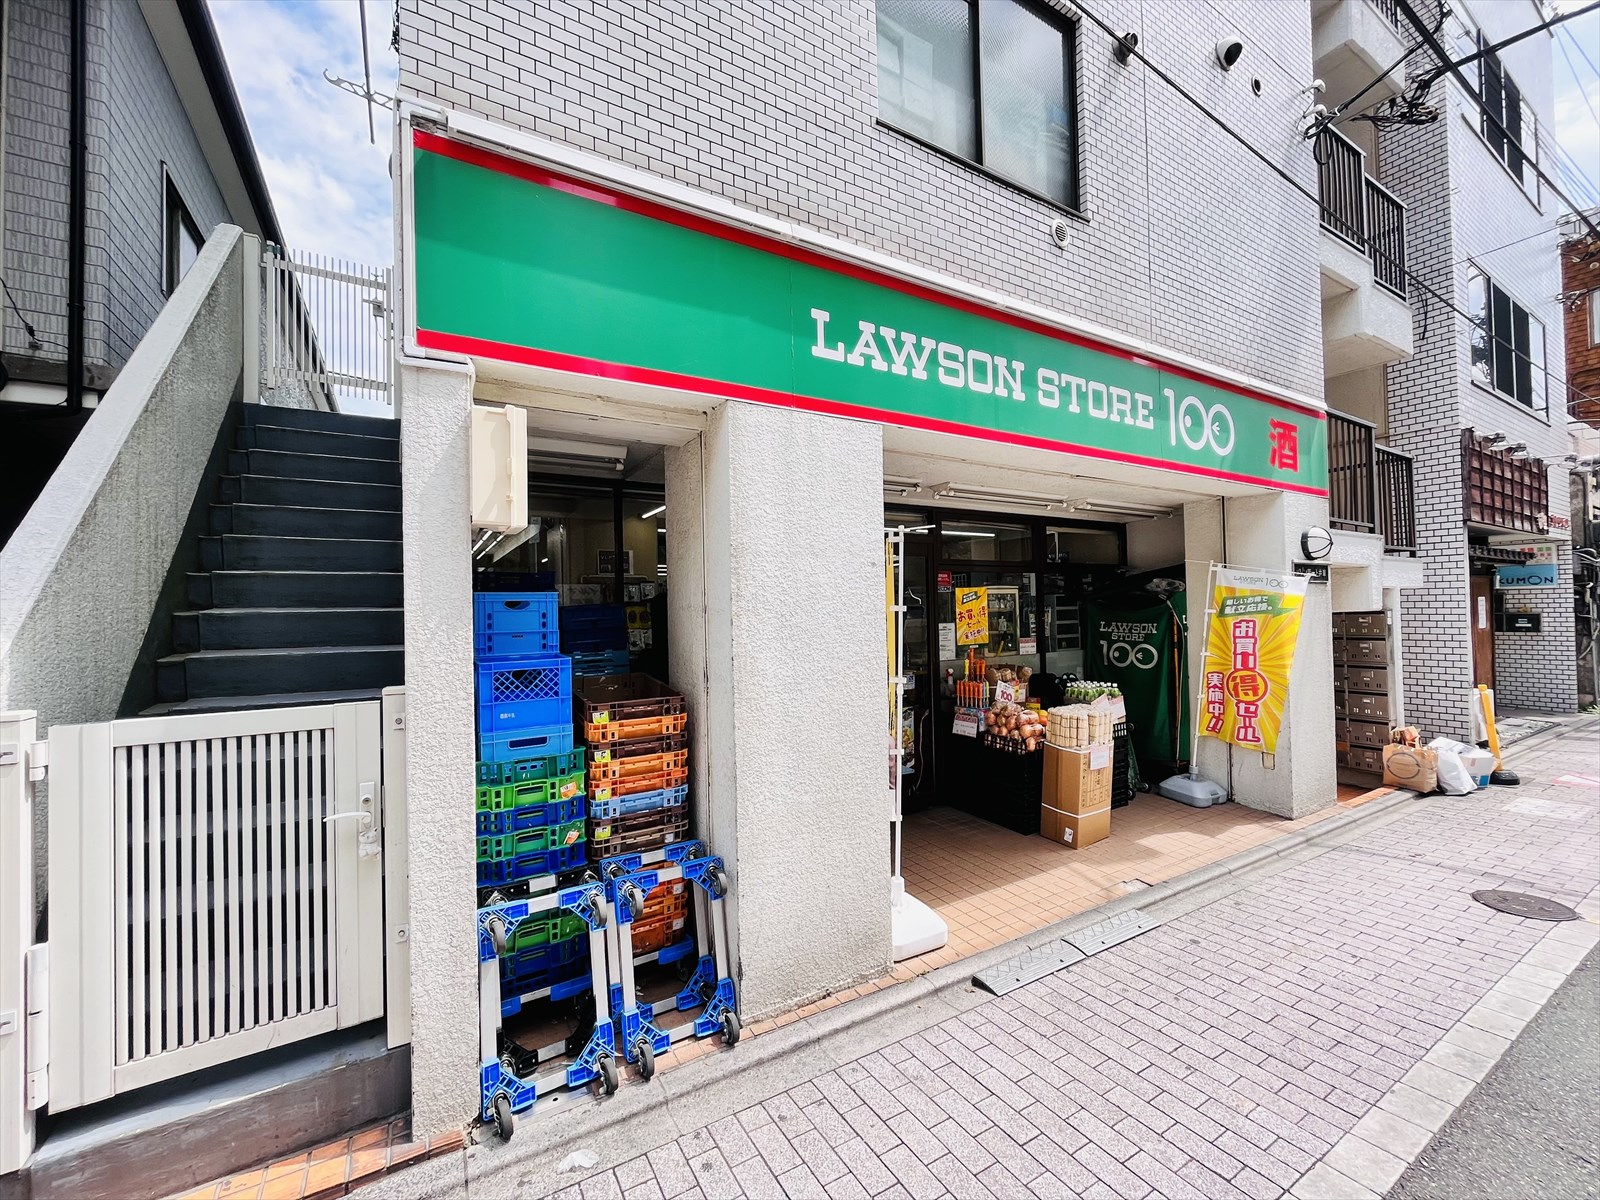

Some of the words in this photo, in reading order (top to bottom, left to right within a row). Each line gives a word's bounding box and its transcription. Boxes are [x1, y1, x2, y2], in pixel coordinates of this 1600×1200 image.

[811, 308, 1025, 401] LAWSON
[1038, 368, 1154, 430] STORE
[1165, 388, 1236, 456] 100
[1268, 418, 1299, 473] 酒
[1233, 575, 1264, 583] LAWSON
[1265, 577, 1288, 589] 100
[1099, 620, 1158, 634] LAWSON
[1111, 632, 1146, 642] STORE
[1099, 639, 1159, 670] 100
[1000, 689, 1013, 702] 100
